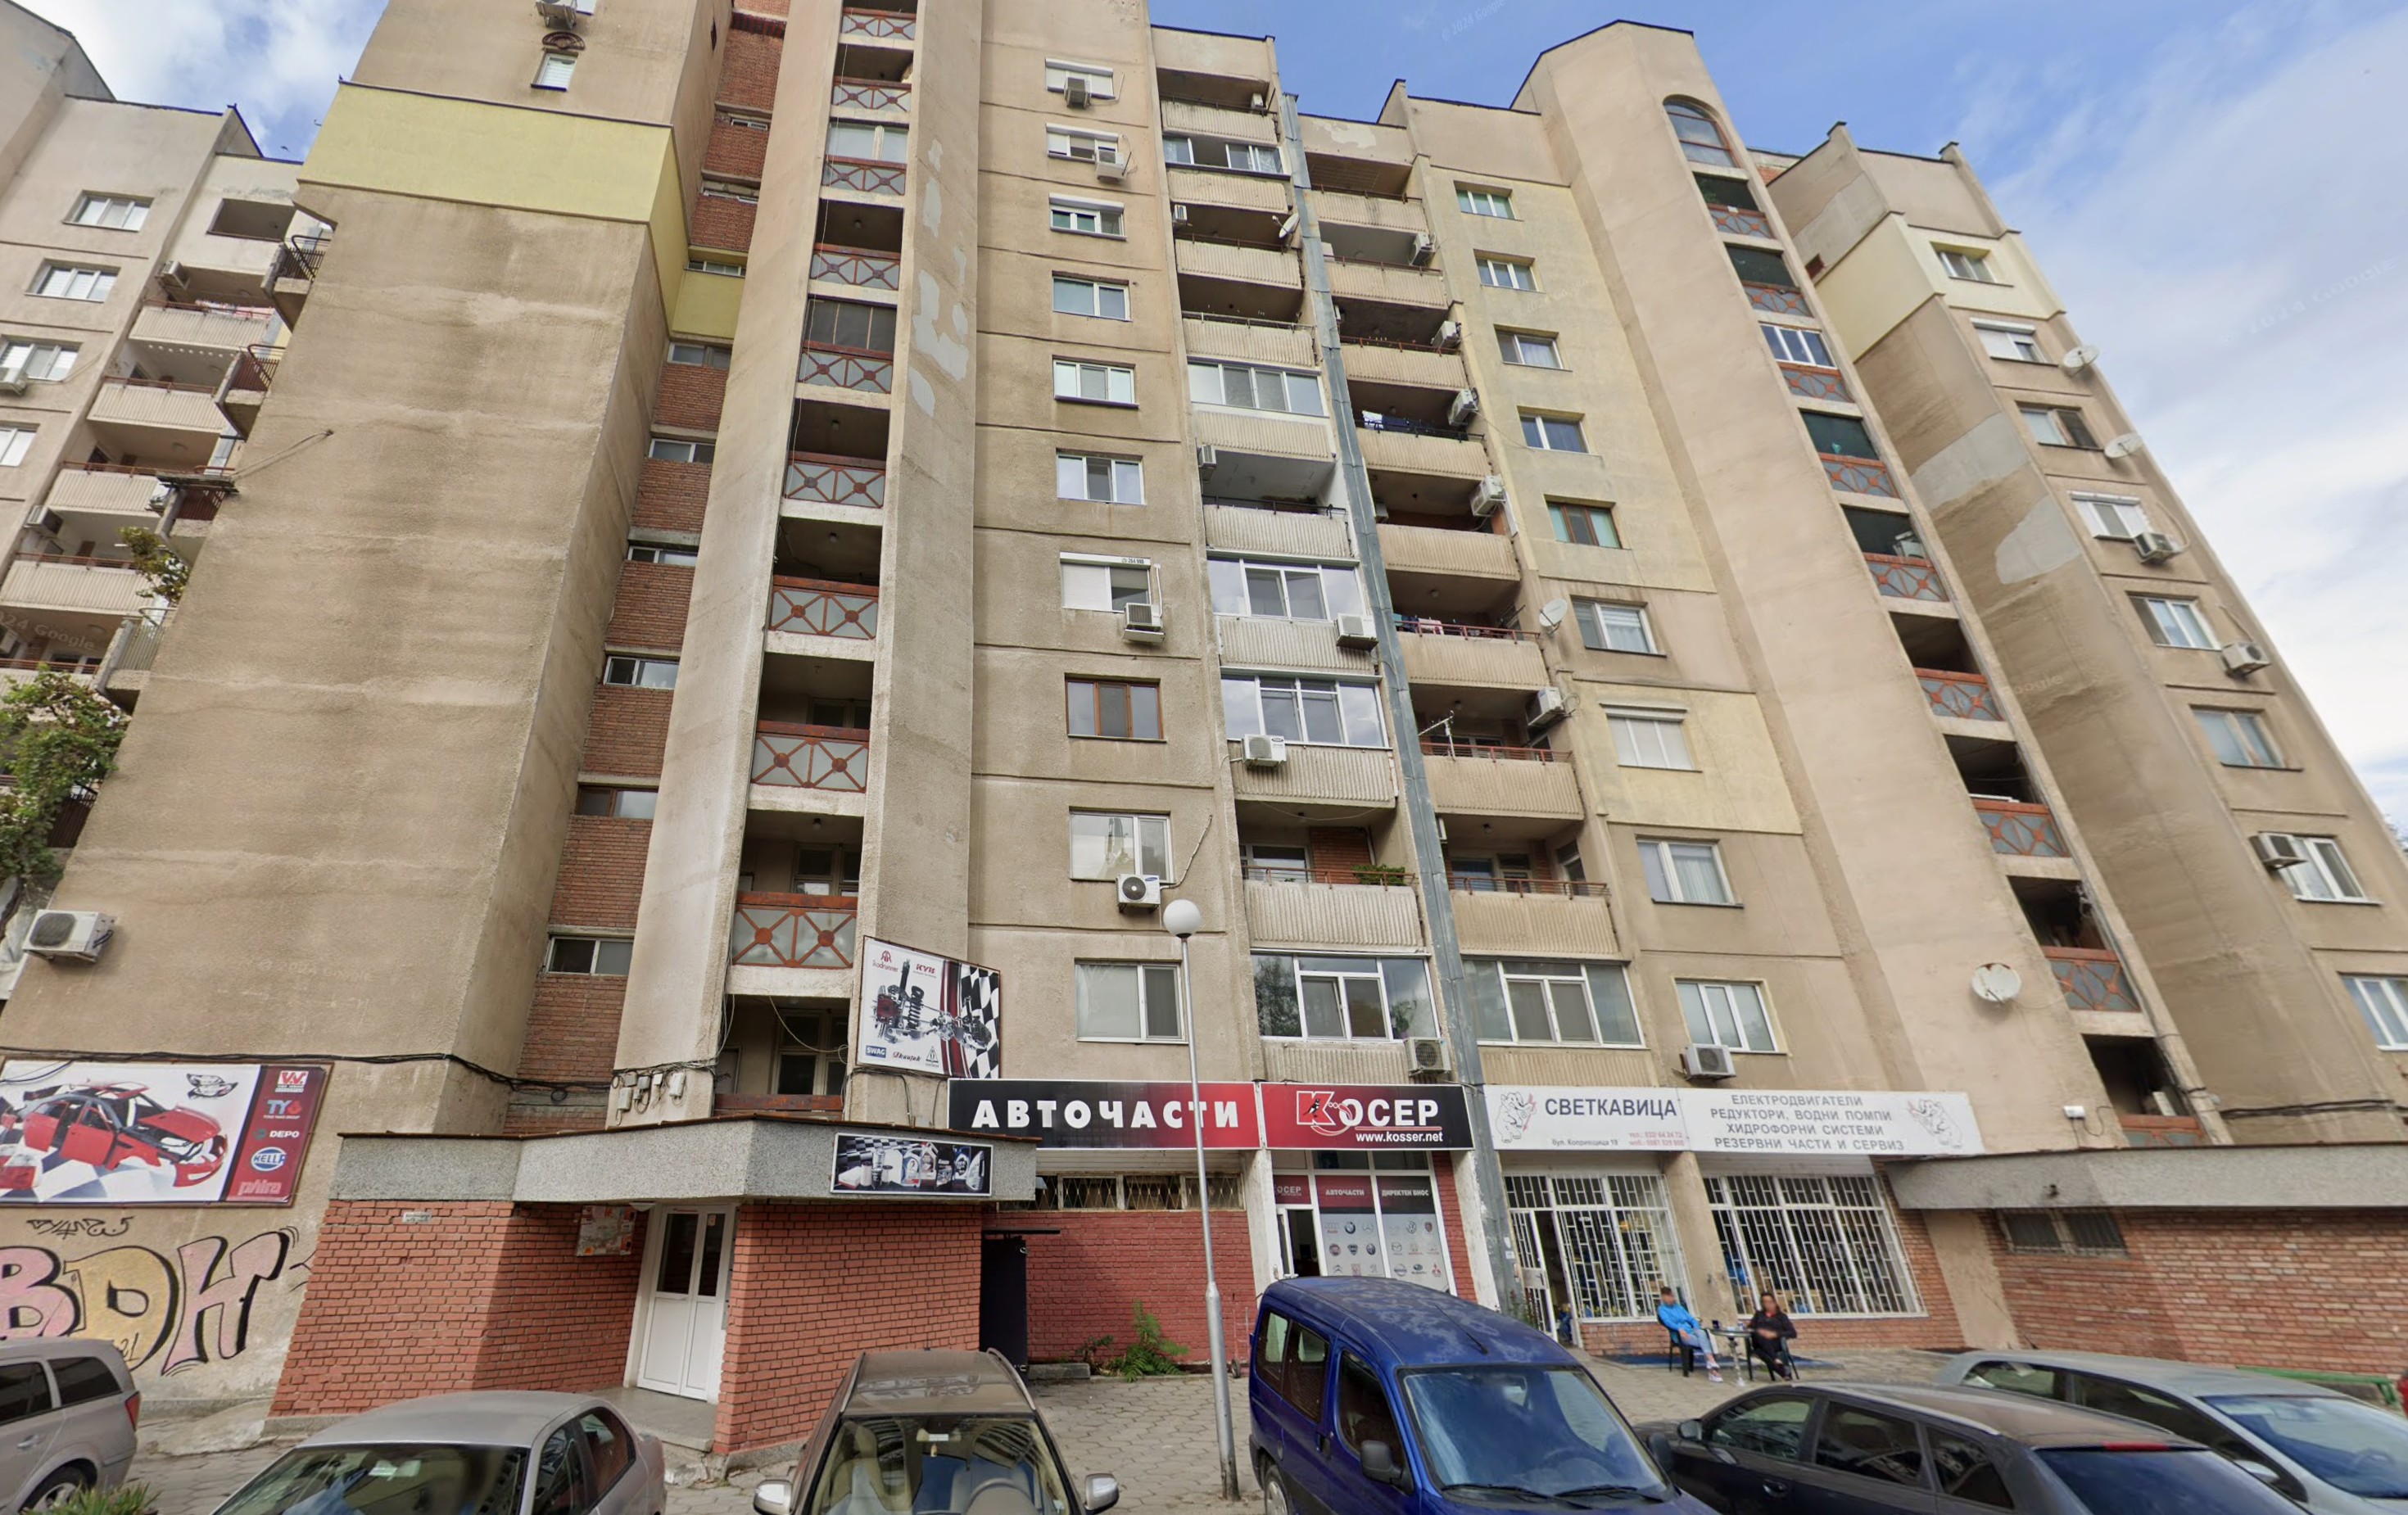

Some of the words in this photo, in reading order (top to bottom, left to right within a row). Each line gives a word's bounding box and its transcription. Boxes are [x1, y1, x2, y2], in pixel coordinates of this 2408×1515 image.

[867, 1047, 885, 1056] SWAG
[1731, 1094, 1863, 1106] ЕЛЕКТРОДВИГАТЕЛИ
[971, 1100, 1239, 1128] АВТОЧАСТИ
[1297, 1091, 1439, 1127] КОСЕР
[1545, 1098, 1677, 1119] СВЕТКАВИЦА
[1710, 1108, 1789, 1120] РЕДУКТОРИ,
[1795, 1110, 1839, 1121] ВОДНИ
[1845, 1110, 1891, 1121] ПОМПИ
[269, 1130, 300, 1138] DEPO
[1727, 1123, 1815, 1136] ХИДРОФОРНИ
[1823, 1125, 1883, 1136] СИСТЕМИ
[1356, 1131, 1444, 1142] www.kosser.net
[1714, 1137, 1782, 1149] РЕЗЕРВНИ
[1788, 1139, 1831, 1150] ЧАСТИ
[1836, 1140, 1846, 1150] И
[1853, 1140, 1904, 1151] СЕРВИЗ
[1277, 1186, 1301, 1194] ОСЕР
